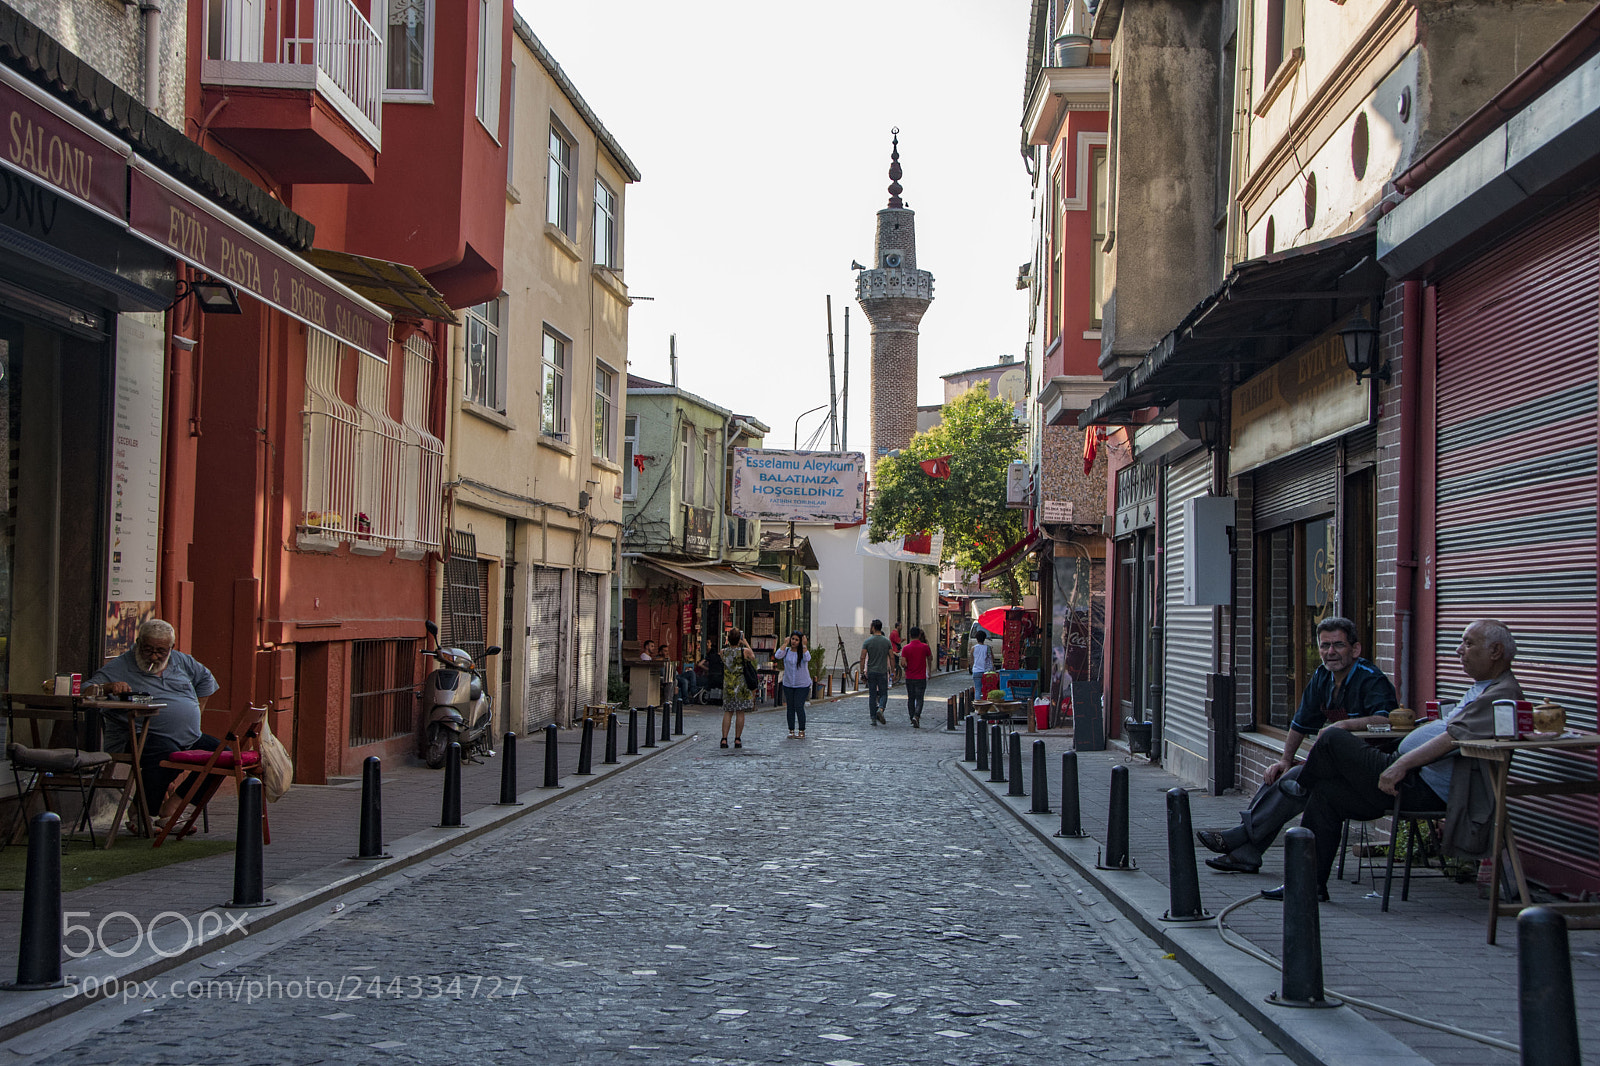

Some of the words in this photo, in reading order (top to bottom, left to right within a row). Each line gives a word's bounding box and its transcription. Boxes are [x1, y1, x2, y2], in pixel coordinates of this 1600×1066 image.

[9, 111, 93, 200] SALONU
[168, 205, 208, 263] EVİN
[220, 236, 262, 294] PASTA
[272, 268, 281, 304] &
[290, 277, 327, 328] BÖREK
[335, 304, 373, 350] SALONU
[746, 456, 800, 470] Esselamu
[803, 459, 854, 473] Aleykum
[760, 473, 839, 485] BALATIMIZA
[752, 485, 845, 497] HOŞGELDİNİZ
